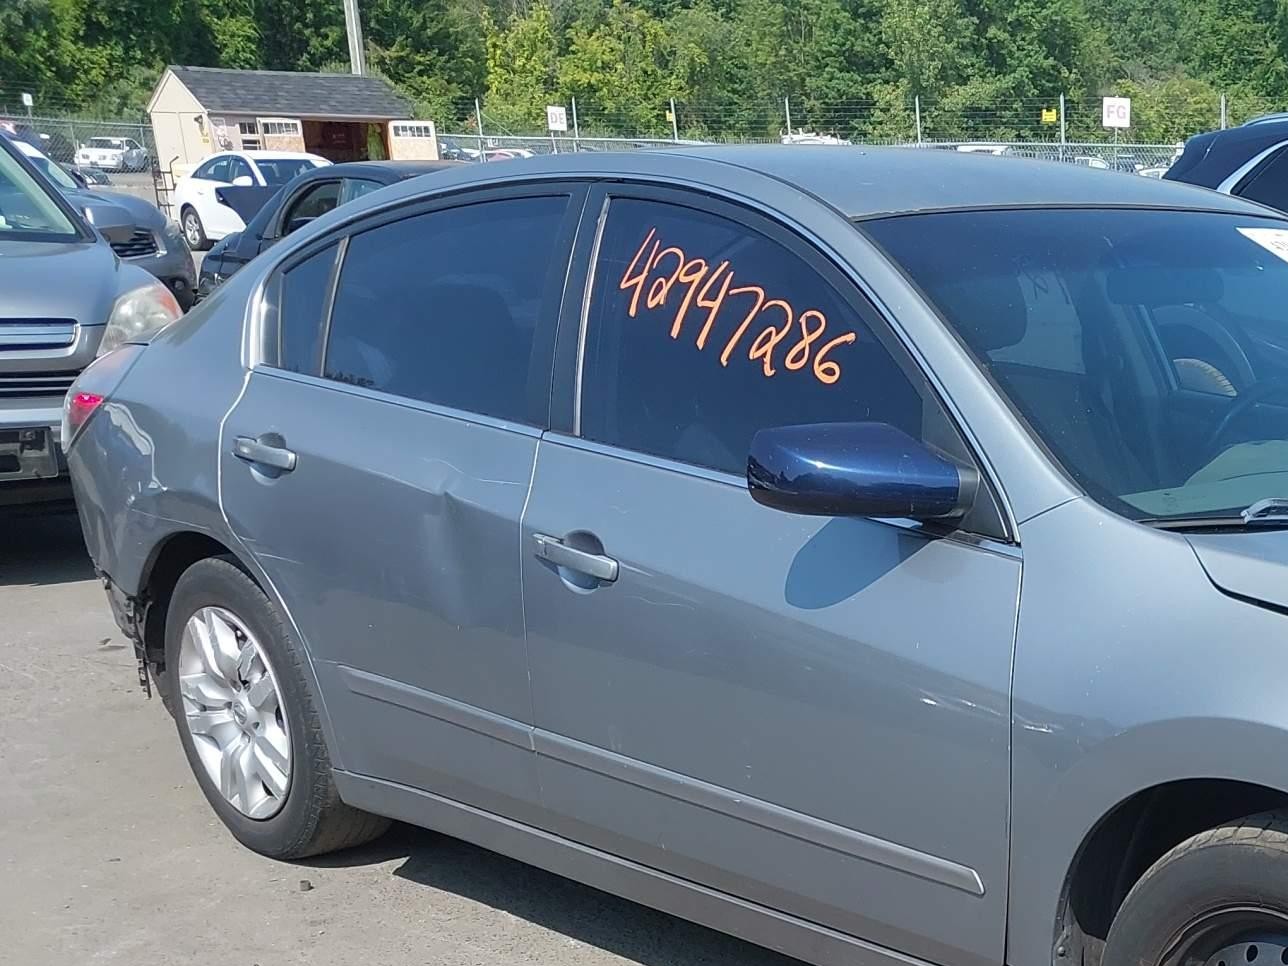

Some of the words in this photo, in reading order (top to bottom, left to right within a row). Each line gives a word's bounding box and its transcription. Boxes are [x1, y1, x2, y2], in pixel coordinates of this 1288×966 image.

[550, 112, 565, 125] DE
[1106, 104, 1127, 120] FG
[620, 227, 856, 384] 42947286
